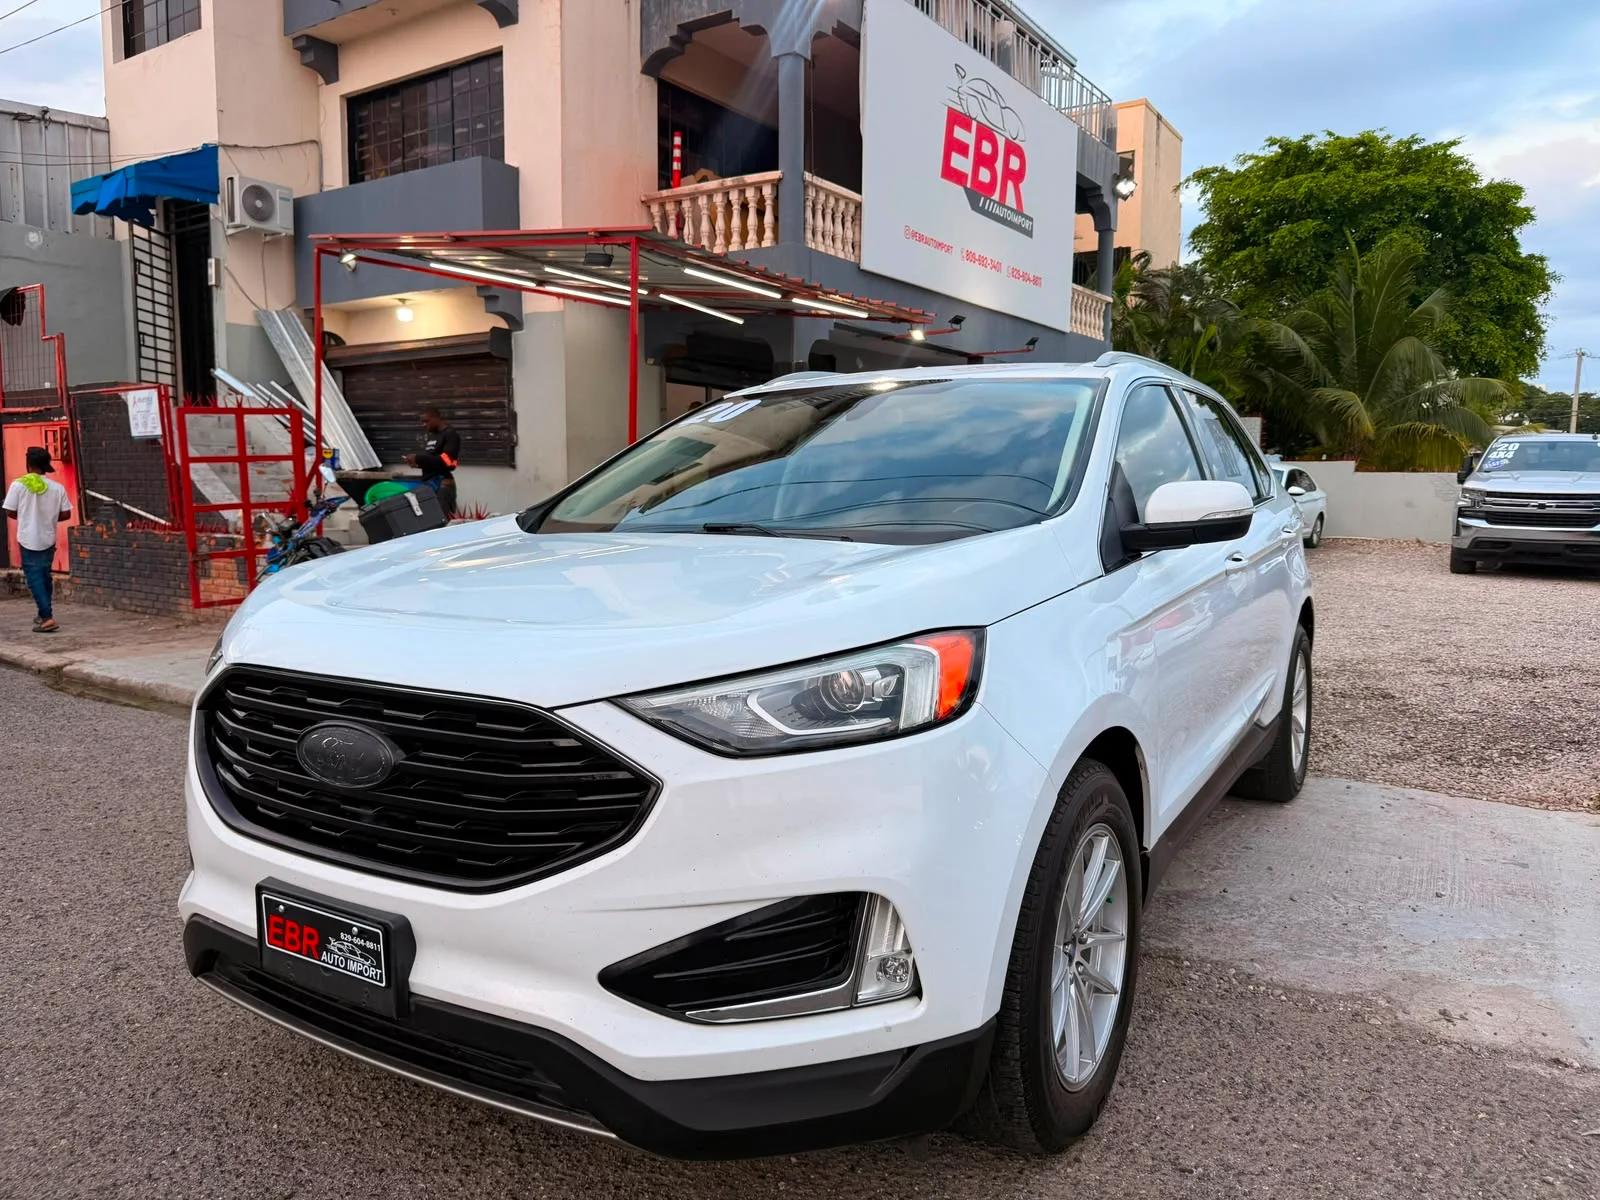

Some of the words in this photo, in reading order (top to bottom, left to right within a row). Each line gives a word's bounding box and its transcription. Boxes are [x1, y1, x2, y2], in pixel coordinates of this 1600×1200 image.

[940, 105, 1026, 213] EBR
[268, 914, 319, 959] EBR
[340, 932, 381, 952] 829-604-8811
[320, 951, 346, 968] AUTO
[347, 961, 382, 980] IMPORT
